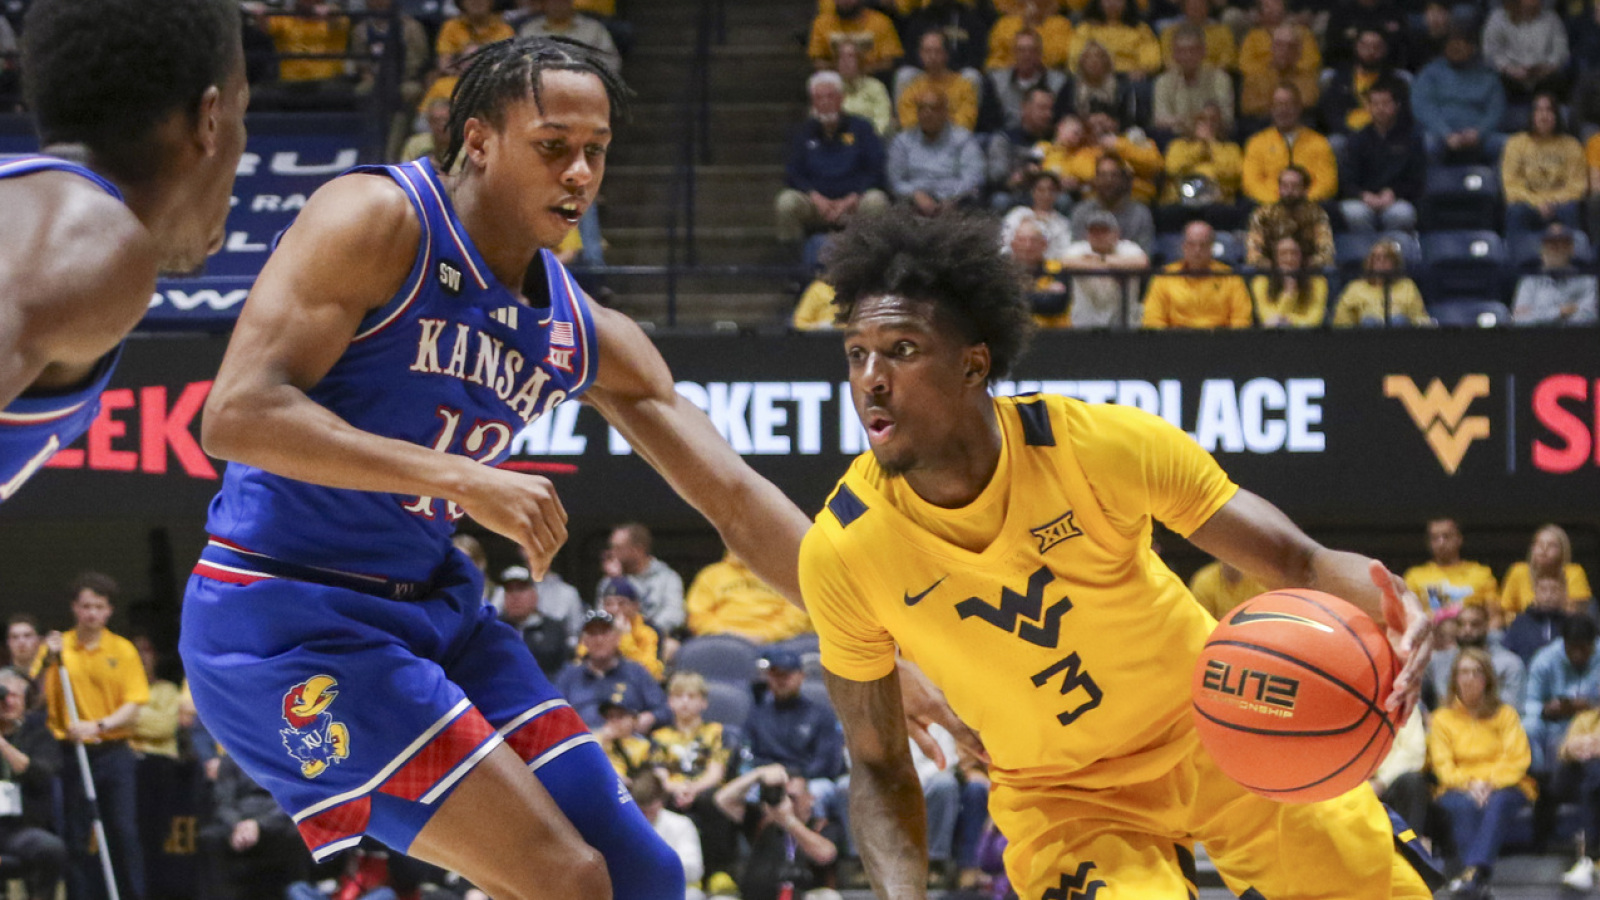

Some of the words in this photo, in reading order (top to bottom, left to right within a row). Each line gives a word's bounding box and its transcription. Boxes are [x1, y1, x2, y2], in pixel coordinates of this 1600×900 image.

[439, 262, 462, 292] SW
[1030, 651, 1104, 727] 3
[1203, 659, 1300, 709] ELITE
[301, 730, 323, 750] KU
